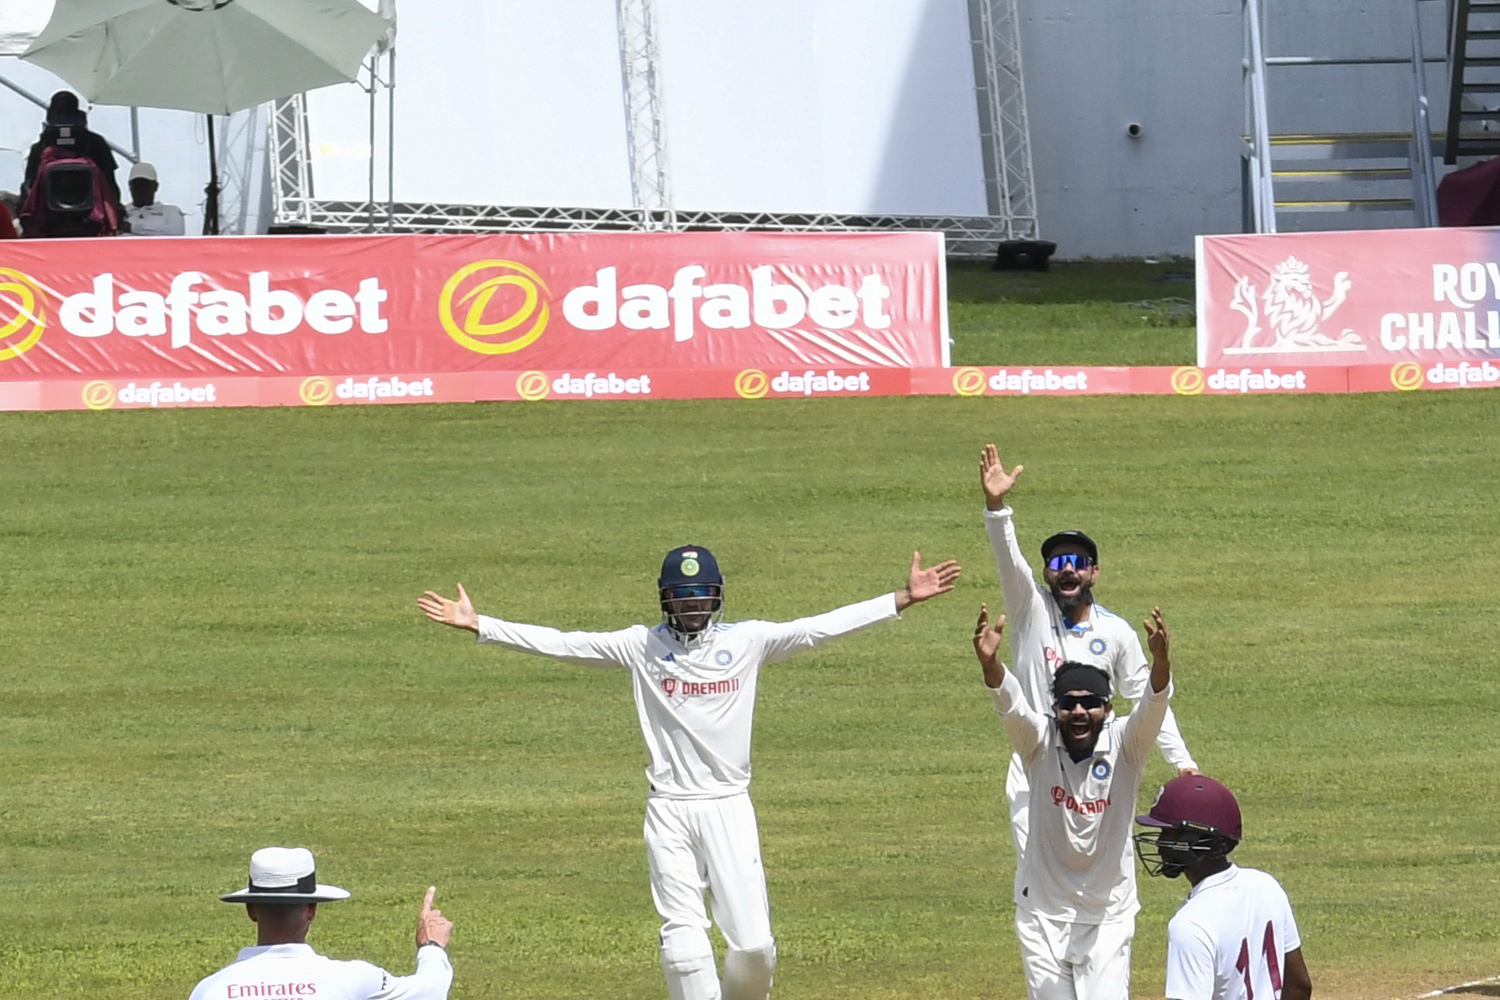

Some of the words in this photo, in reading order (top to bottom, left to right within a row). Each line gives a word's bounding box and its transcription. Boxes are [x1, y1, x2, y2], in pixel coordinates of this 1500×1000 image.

[59, 270, 388, 349] dafabet
[562, 265, 891, 342] dafabet
[336, 376, 434, 401] dafabet
[553, 372, 651, 397] dafabet
[771, 370, 870, 395] dafabet
[989, 368, 1087, 393] dafabet
[1207, 368, 1306, 391] dafabet
[118, 381, 216, 407] dafabet
[681, 677, 740, 696] DREAM11
[227, 981, 317, 999] Emirates
